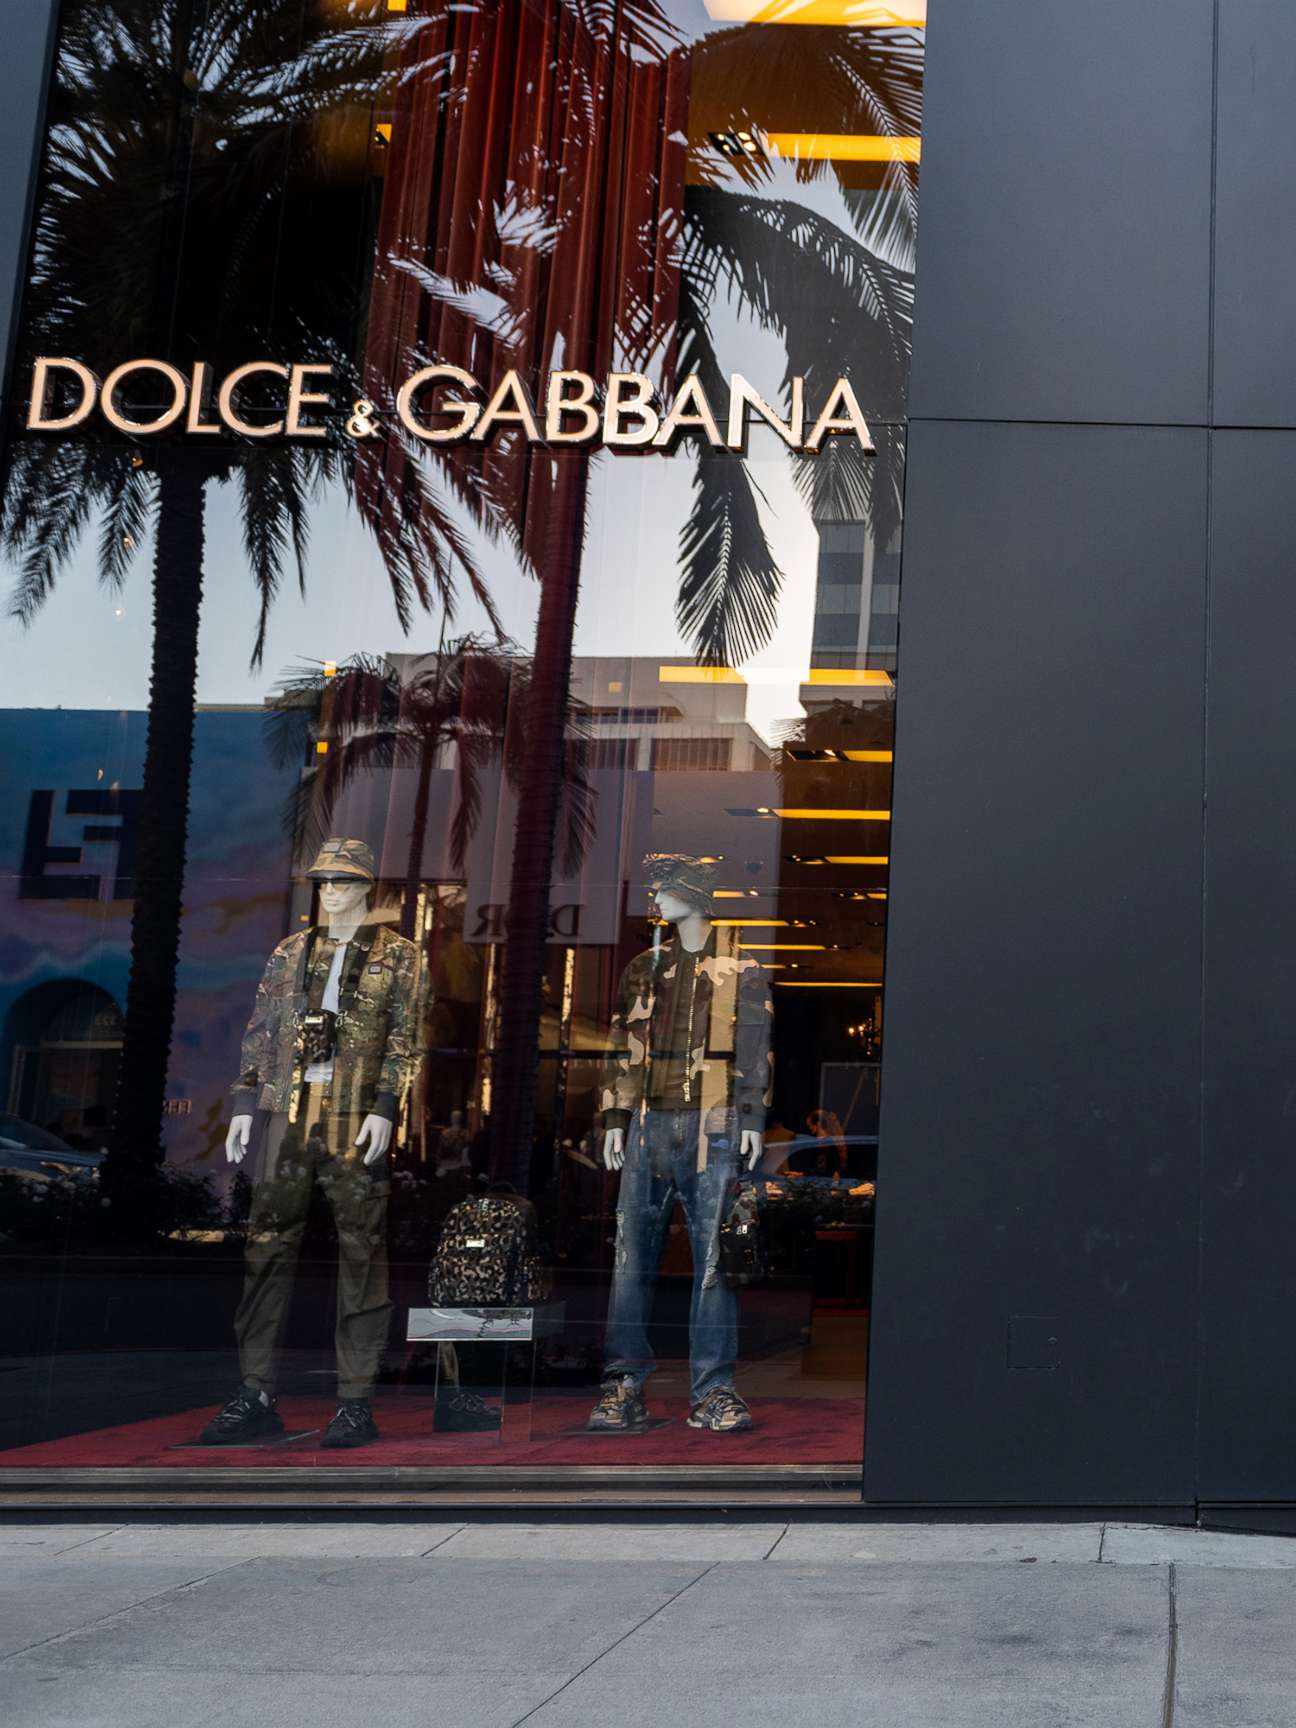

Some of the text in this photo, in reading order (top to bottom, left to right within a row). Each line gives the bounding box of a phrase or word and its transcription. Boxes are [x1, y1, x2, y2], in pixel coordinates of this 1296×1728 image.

[26, 355, 877, 456] DOLCE & GABBANA
